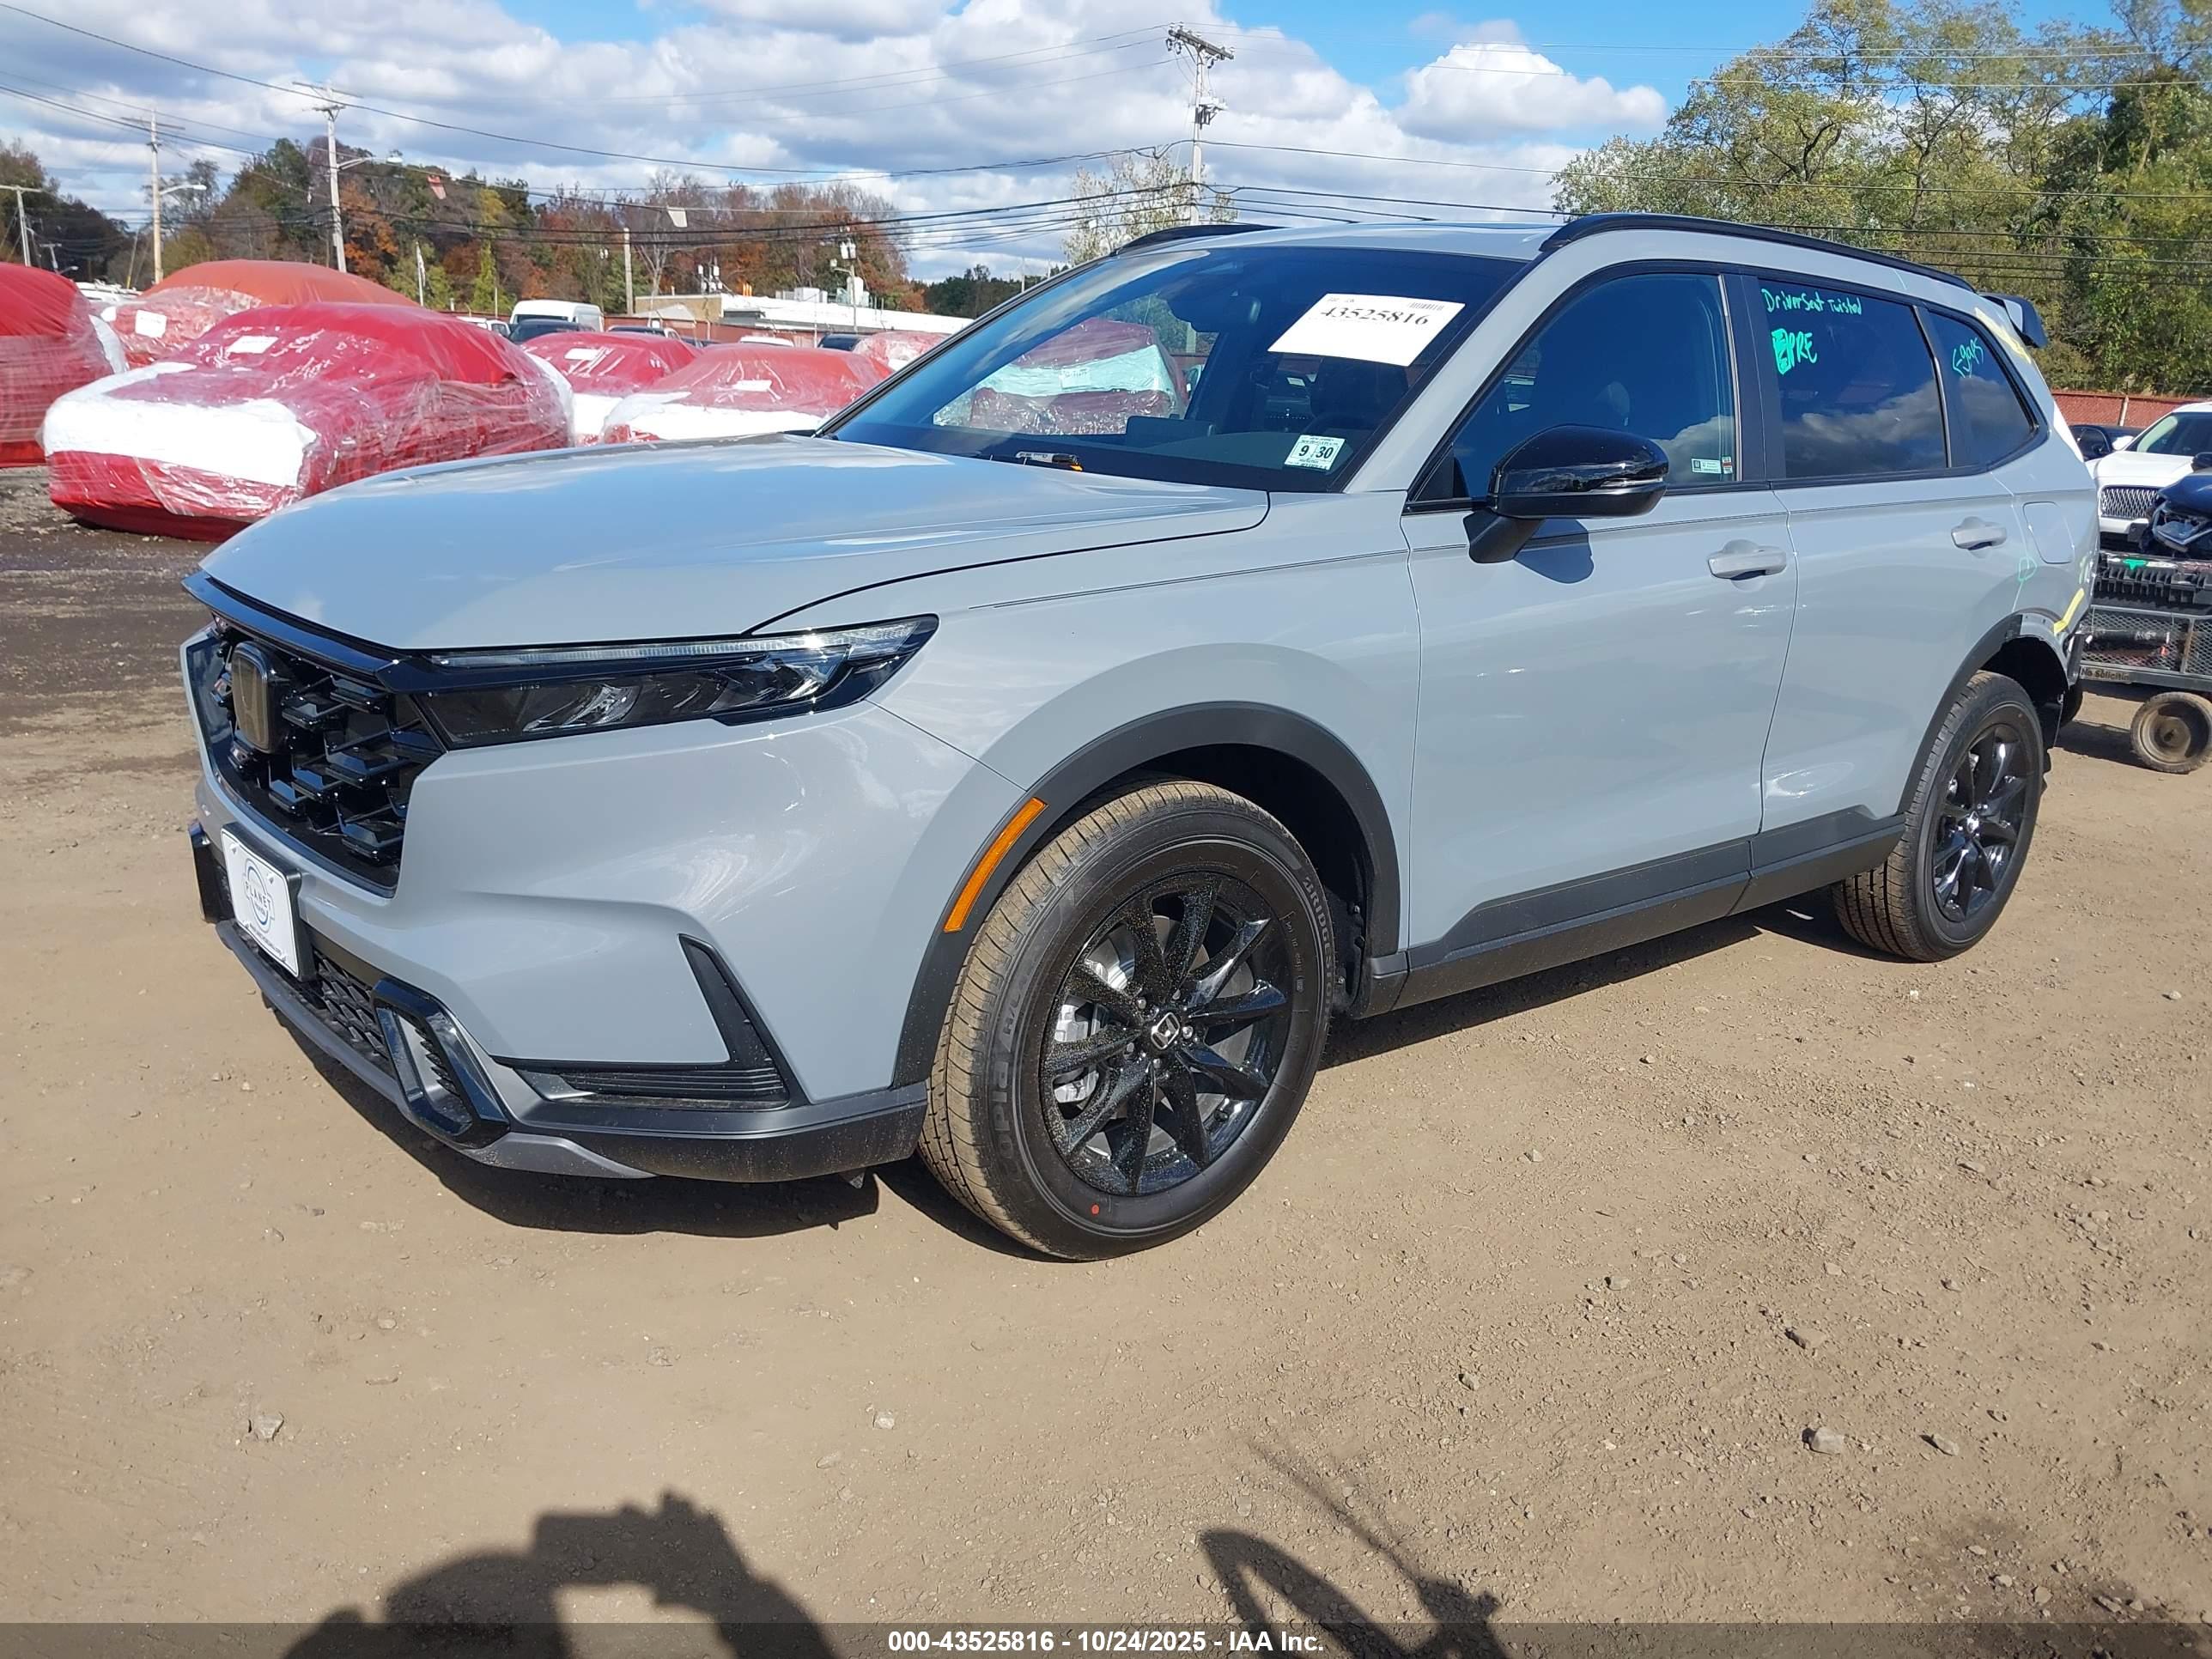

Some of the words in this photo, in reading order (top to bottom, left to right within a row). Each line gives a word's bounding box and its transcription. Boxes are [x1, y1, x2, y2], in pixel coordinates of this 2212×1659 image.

[1321, 307, 1430, 325] 43525816
[1298, 445, 1310, 456] 9
[1316, 447, 1334, 459] 30
